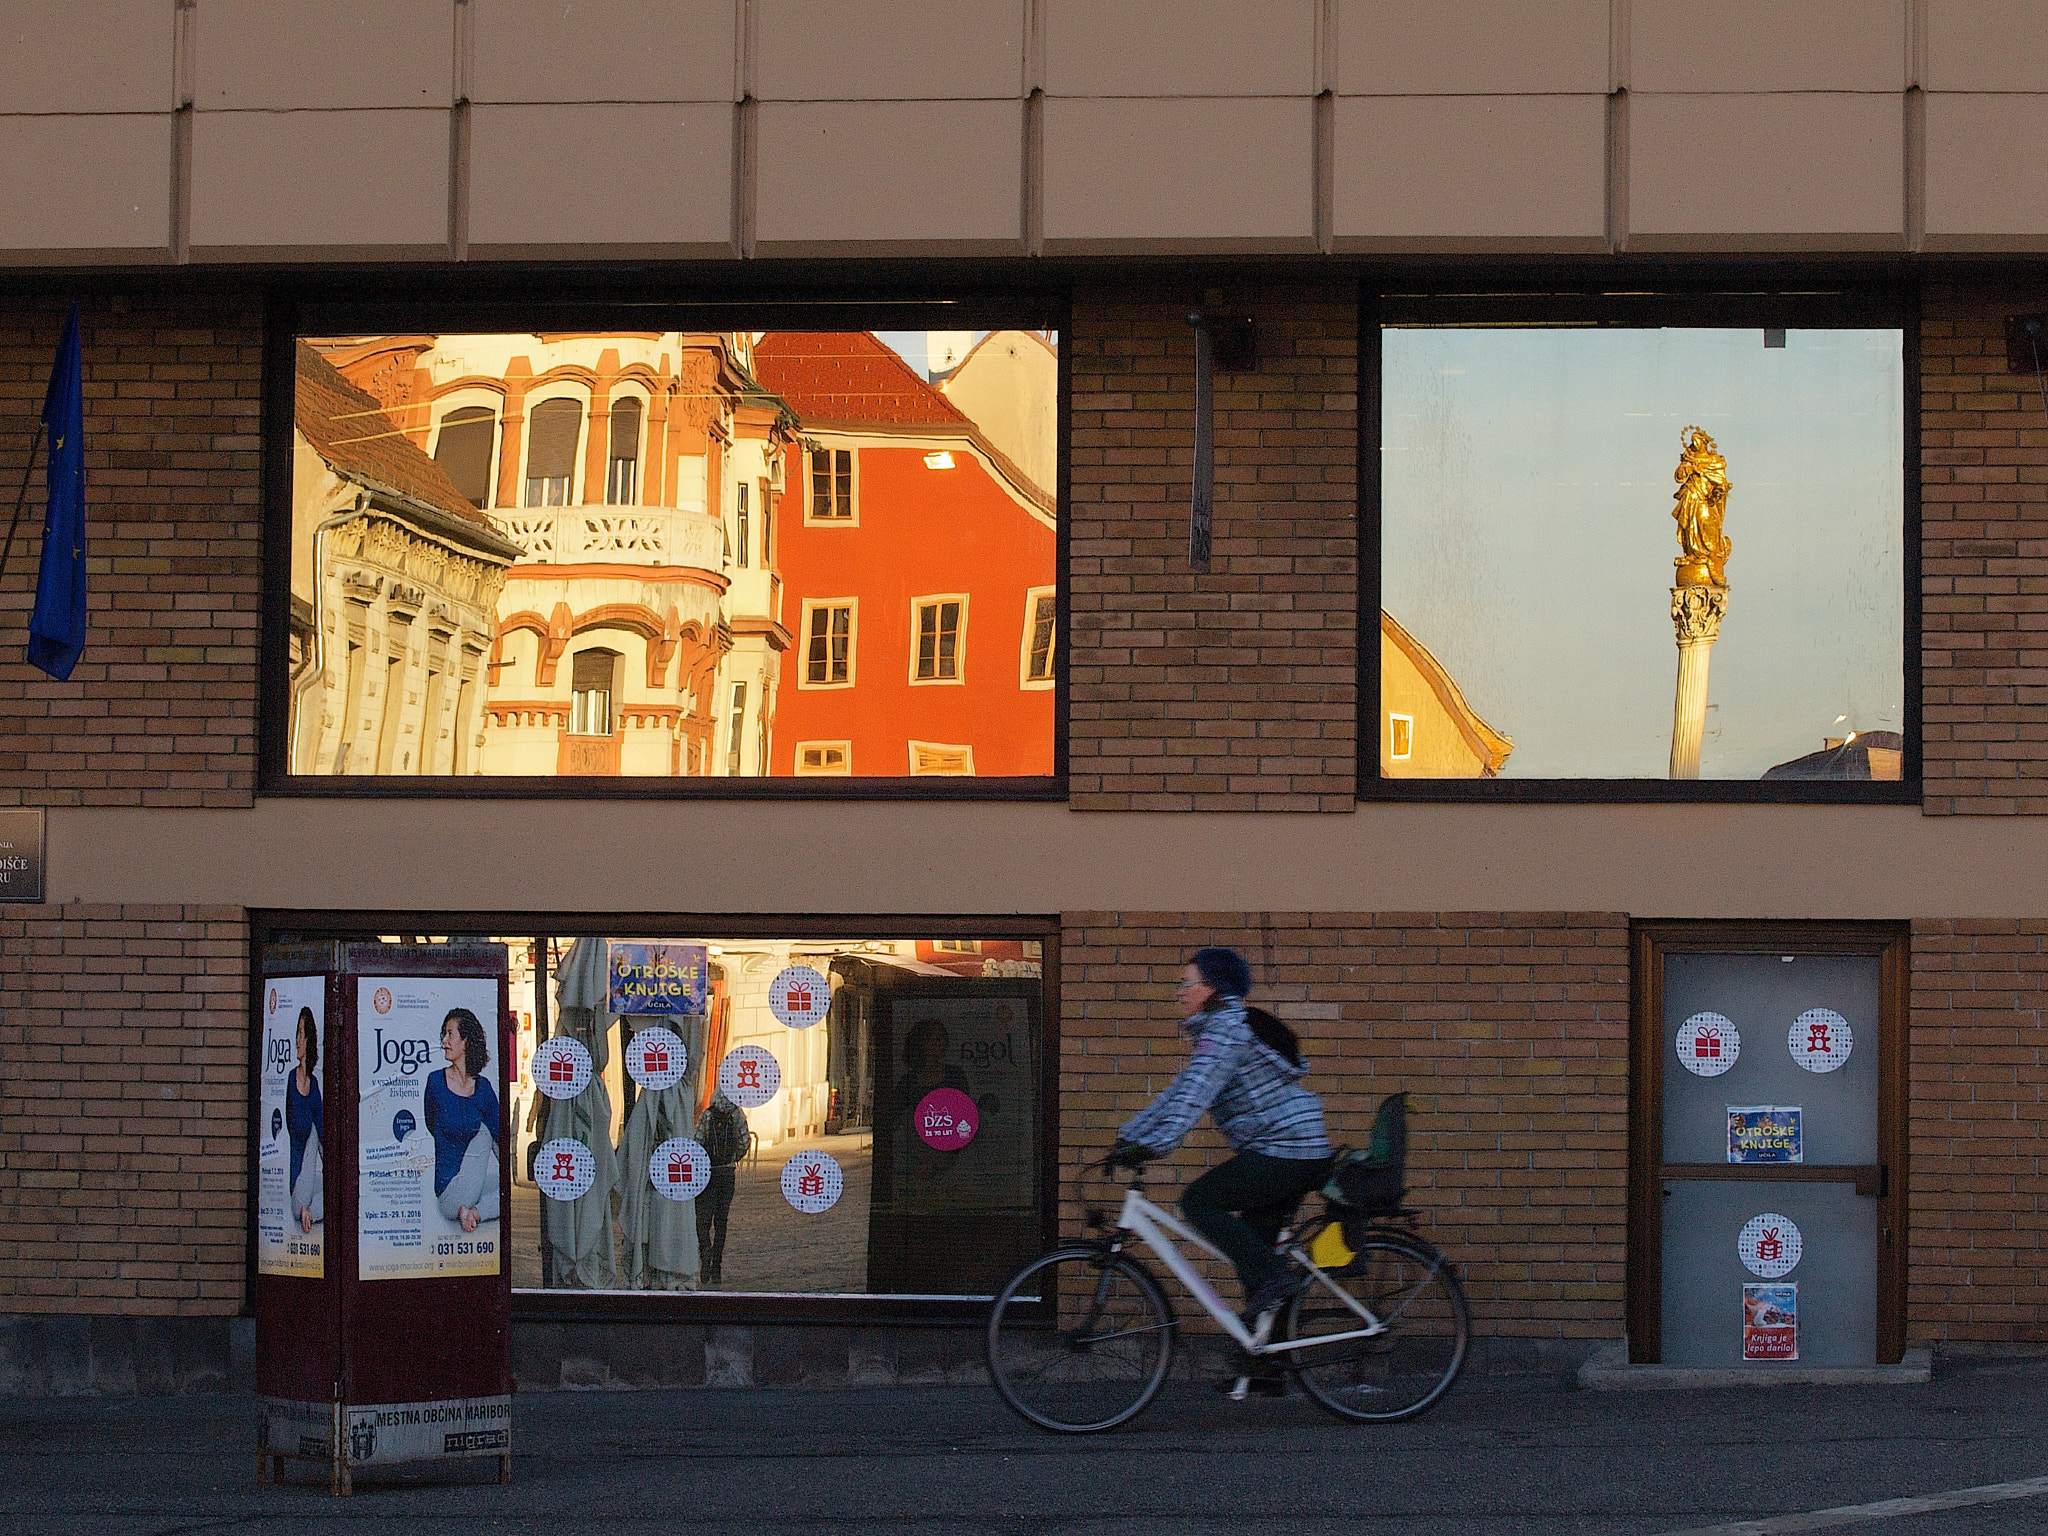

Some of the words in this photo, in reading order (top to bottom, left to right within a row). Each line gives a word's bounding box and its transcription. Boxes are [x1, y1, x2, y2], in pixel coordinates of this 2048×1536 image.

[618, 961, 698, 979] OTROŠKE
[624, 982, 691, 997] KNJIGE
[647, 1001, 671, 1009] UČILA
[265, 1028, 291, 1074] Joga
[373, 1028, 432, 1075] Joga
[389, 1087, 420, 1099] življenju
[924, 1115, 953, 1128] DZS
[1735, 1123, 1795, 1137] OTROŠKE
[1741, 1139, 1790, 1150] KNJIGE
[407, 1210, 421, 1218] 2016
[300, 1243, 309, 1256] 531
[438, 1243, 454, 1255] 031
[457, 1242, 473, 1255] 531
[476, 1241, 494, 1254] 690
[1751, 1334, 1777, 1344] Knjiga
[1778, 1334, 1787, 1344] je
[1747, 1343, 1765, 1353] lepo
[1767, 1343, 1793, 1352] darilo!
[376, 1410, 421, 1427] MESTNA
[423, 1405, 462, 1423] OBČINA
[464, 1404, 511, 1421] MARIBOR
[447, 1431, 508, 1449] nigrad
